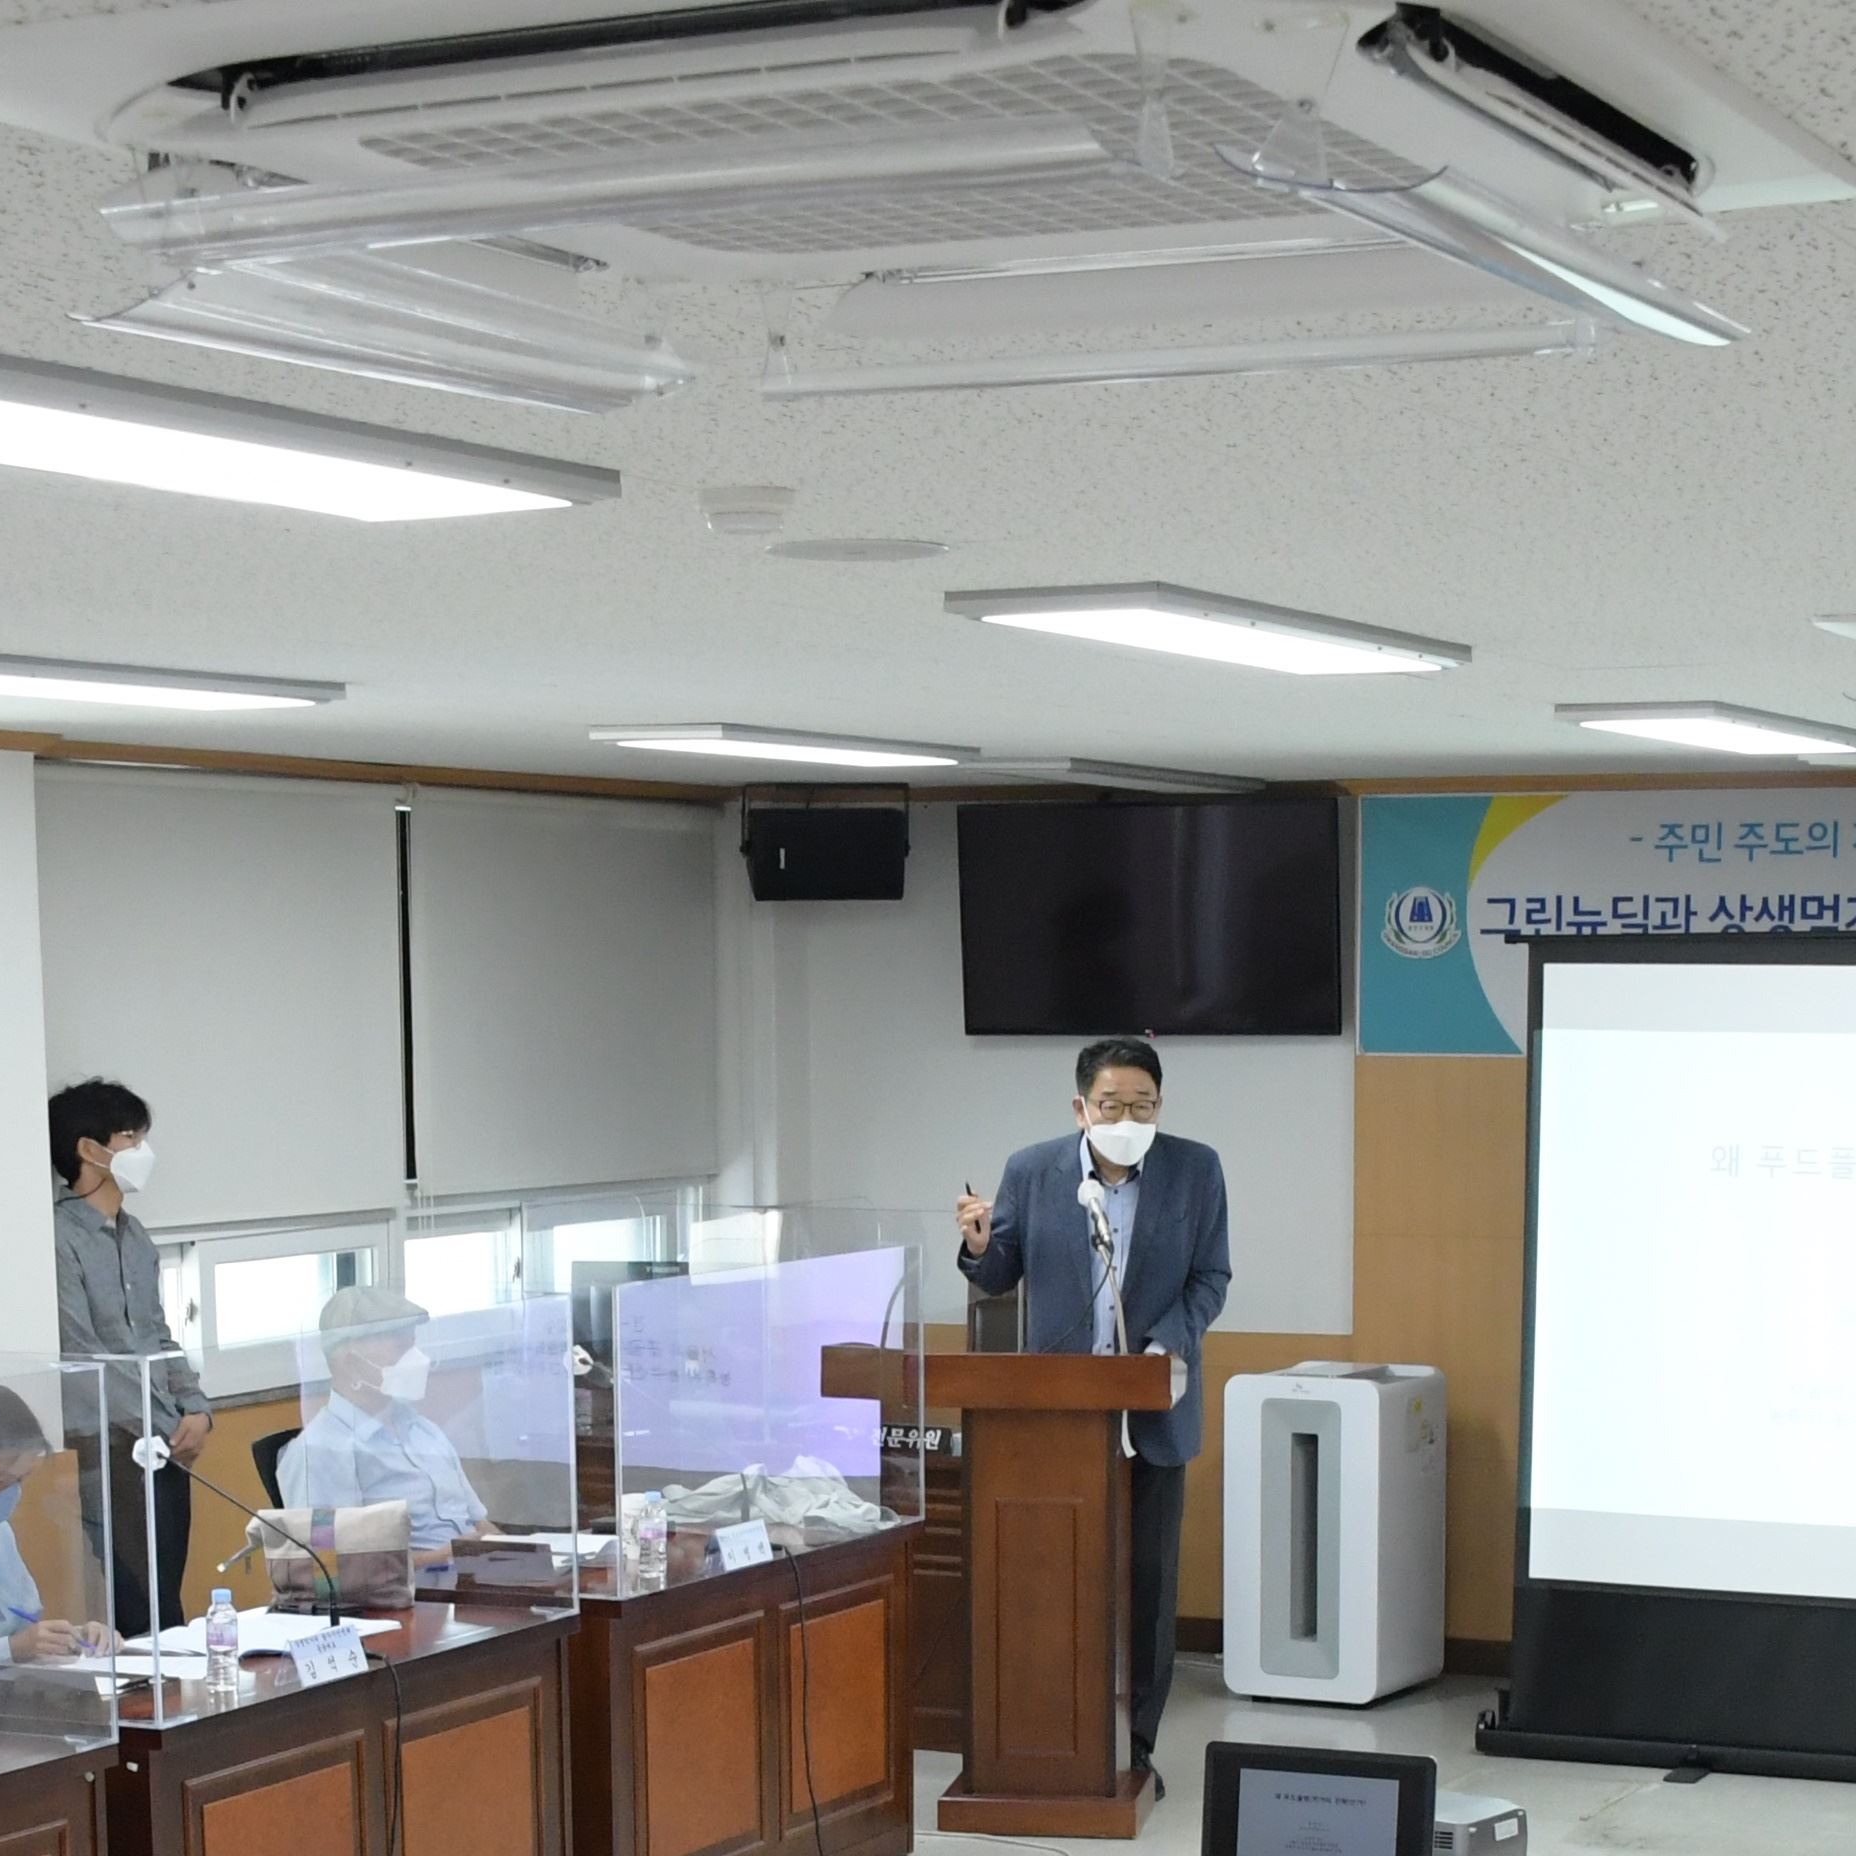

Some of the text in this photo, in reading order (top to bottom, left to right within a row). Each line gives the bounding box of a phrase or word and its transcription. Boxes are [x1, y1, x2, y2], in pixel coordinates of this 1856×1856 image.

[1653, 819, 1724, 863] 주민
[1734, 819, 1840, 859] 주도의
[1479, 893, 1698, 936] 그린뉴딜과
[1709, 1142, 1743, 1180] 왜
